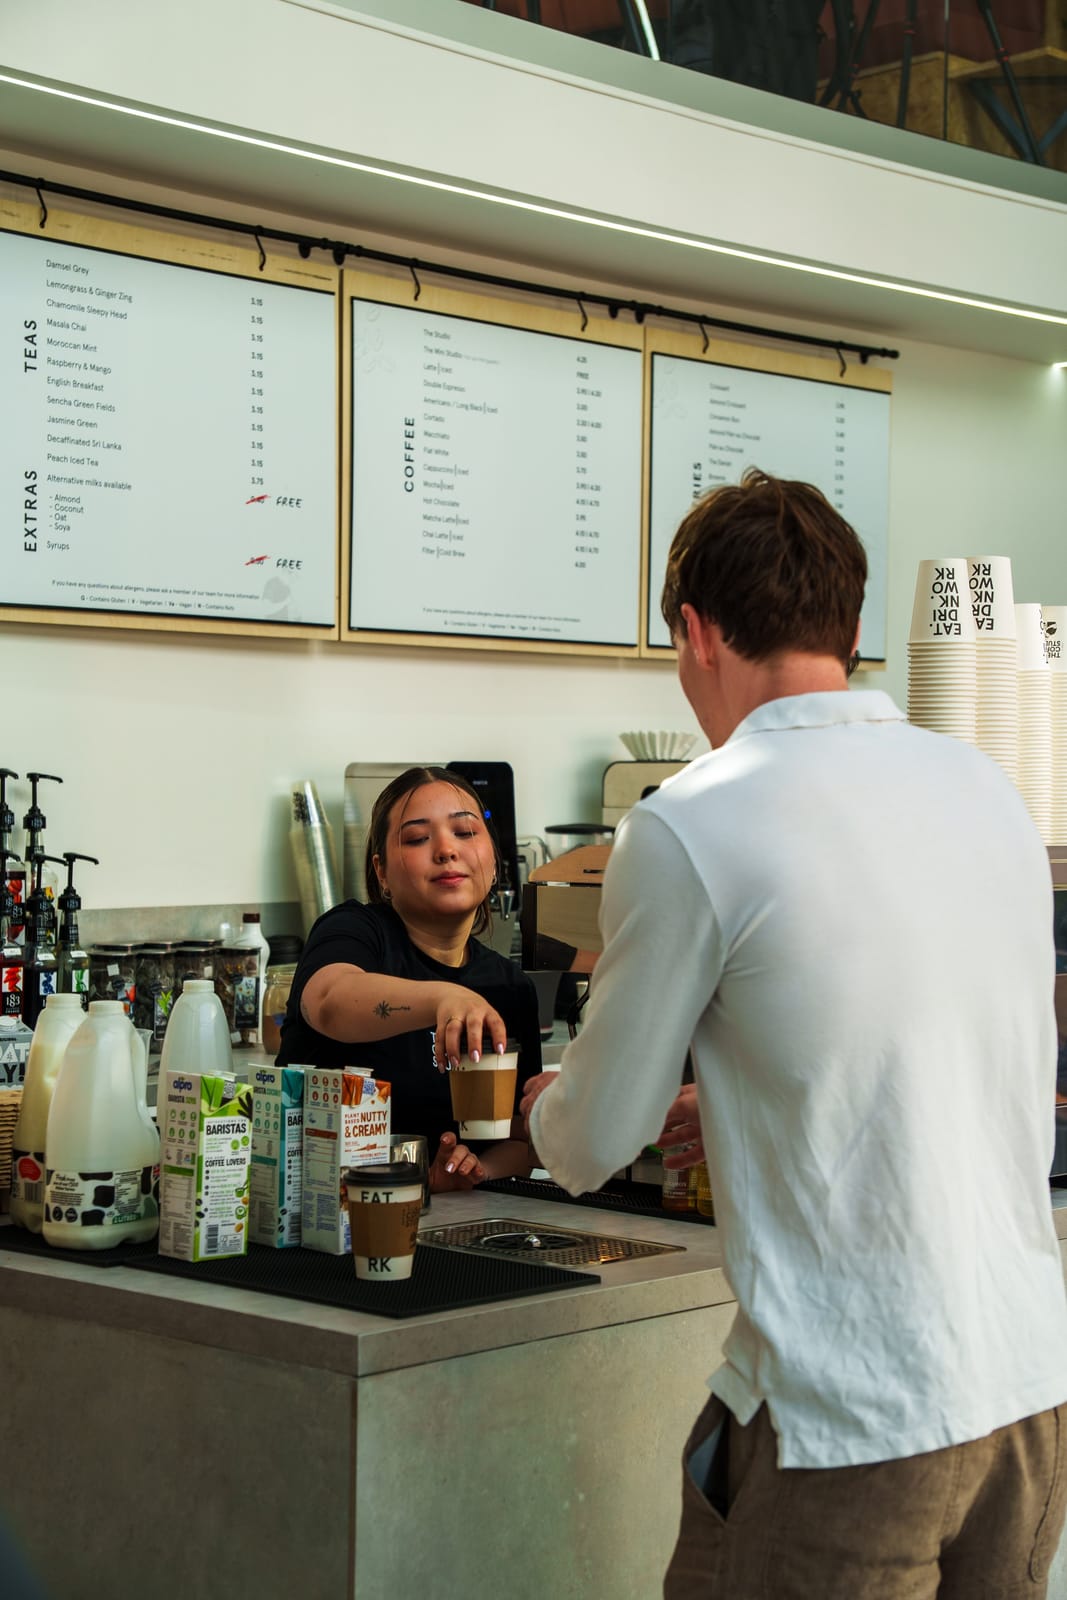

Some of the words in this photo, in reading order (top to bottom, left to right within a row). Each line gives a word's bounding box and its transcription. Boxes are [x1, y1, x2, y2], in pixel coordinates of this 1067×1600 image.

[46, 259, 71, 271] Damsel
[73, 264, 89, 275] Grey
[46, 280, 87, 294] Lemongrass
[95, 288, 116, 299] Ginger
[118, 292, 132, 303] Zing
[46, 299, 85, 313] Chamomile
[87, 306, 108, 318] Sleepy
[110, 309, 127, 320] Head
[46, 319, 69, 329] Masala
[71, 322, 86, 332] Chai
[24, 320, 37, 372] TEAS
[47, 338, 80, 350] Moroccan
[82, 343, 97, 352] Mint
[47, 357, 82, 371] Raspberry
[90, 363, 111, 375] Mango
[47, 376, 70, 387] English
[72, 380, 104, 391] Breakfast
[47, 396, 72, 406] Sencha
[73, 400, 94, 409] Green
[96, 403, 115, 412] Fields
[47, 416, 75, 426] Jasmine
[76, 419, 98, 428] Green
[92, 438, 100, 447] Sri
[102, 440, 122, 450] Lanka
[47, 453, 68, 463] Peach
[70, 456, 84, 465] Iced
[86, 458, 99, 466] Tea
[404, 417, 415, 492] COFFEE
[47, 474, 84, 485] Alternative
[85, 478, 102, 487] milks
[104, 481, 131, 490] available
[693, 462, 702, 499] RIES
[54, 494, 80, 504] Almond
[276, 496, 302, 508] FREE
[24, 470, 37, 552] EXTRAS
[54, 504, 84, 514] Coconut
[54, 522, 70, 532] Soya
[47, 540, 70, 550] Syrups
[276, 558, 302, 570] FREE
[972, 564, 991, 576] RK
[935, 568, 954, 580] RK
[932, 582, 958, 594] WO
[969, 578, 994, 590] WO
[933, 609, 958, 622] DRI
[972, 604, 991, 617] DR
[930, 623, 961, 635] EAT.
[975, 618, 994, 630] EA
[0, 1042, 30, 1062] AT
[0, 1063, 25, 1082] Y!
[361, 1111, 387, 1123] NUTTY
[206, 1123, 246, 1135] BARISTAS
[345, 1127, 351, 1138] &
[353, 1123, 387, 1137] CREAMY
[205, 1159, 224, 1167] COFFEE
[226, 1158, 246, 1166] LOVERS
[368, 1258, 392, 1272] RK
